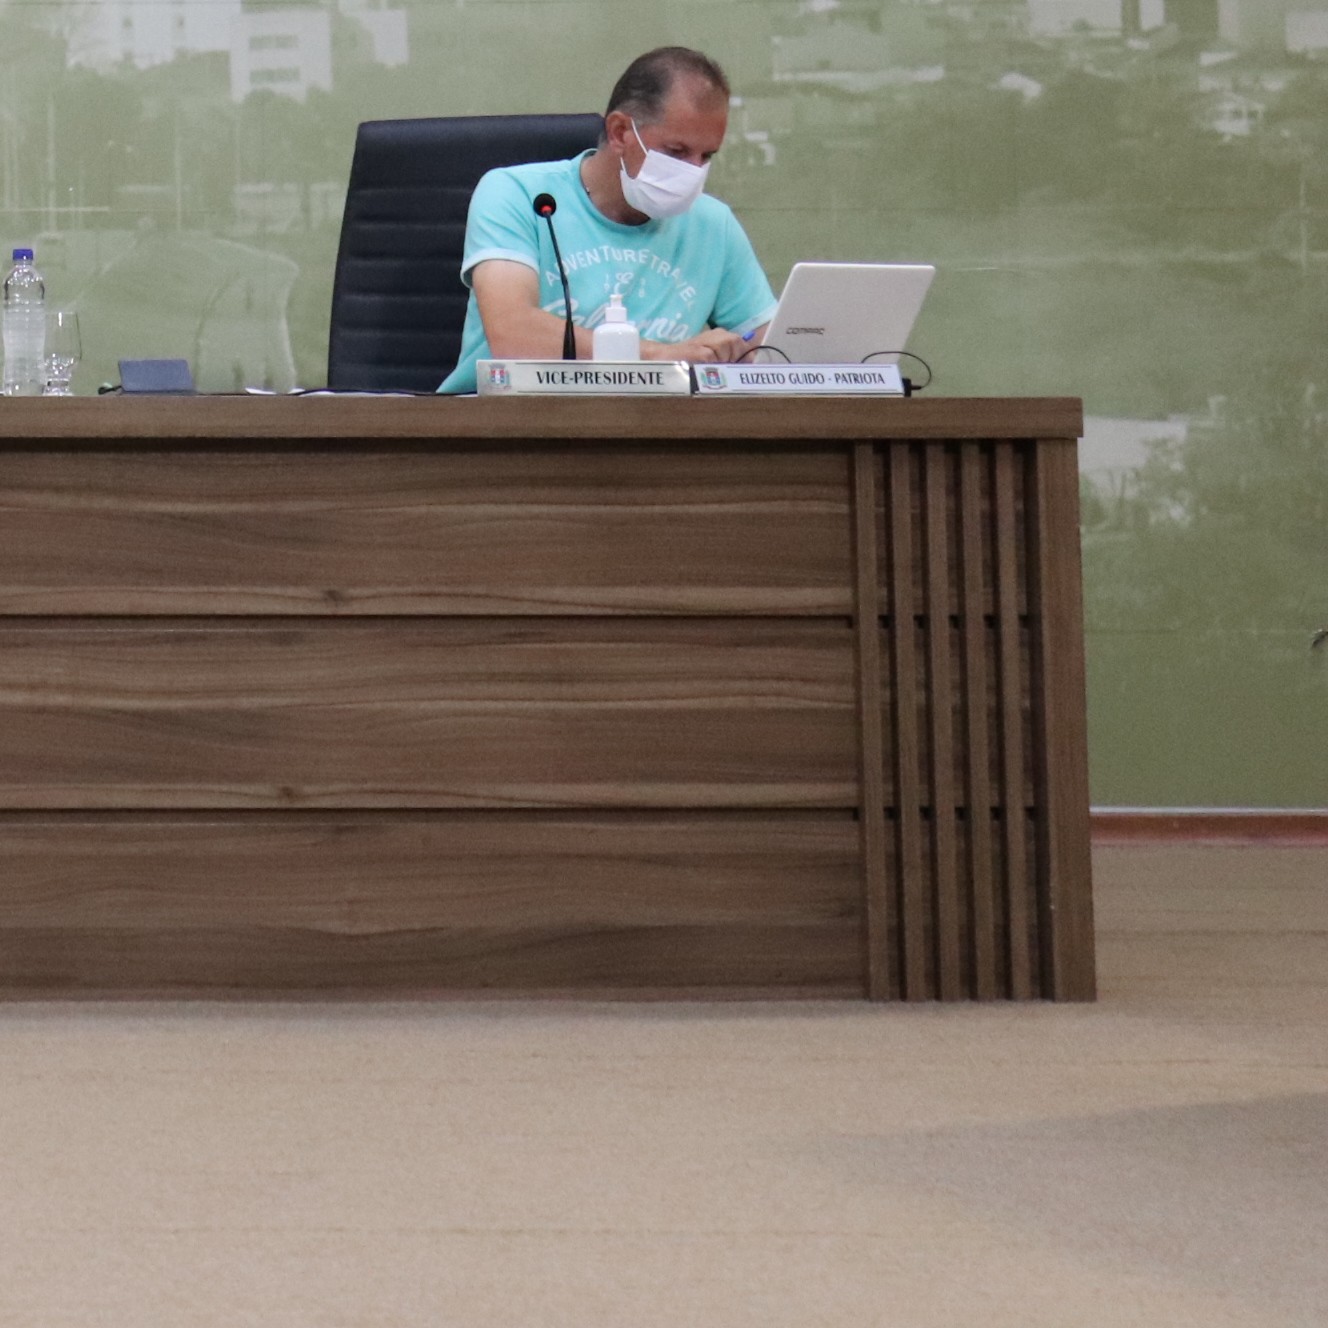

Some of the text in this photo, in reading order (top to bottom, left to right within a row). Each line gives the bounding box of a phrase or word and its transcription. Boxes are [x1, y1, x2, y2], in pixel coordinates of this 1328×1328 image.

[545, 245, 650, 287] ADVENTURE
[536, 371, 664, 386] VICE-PRESIDENTE
[739, 372, 787, 385] ELIZELTO
[789, 373, 825, 385] GUIDO
[835, 372, 885, 385] PATRIOTA
